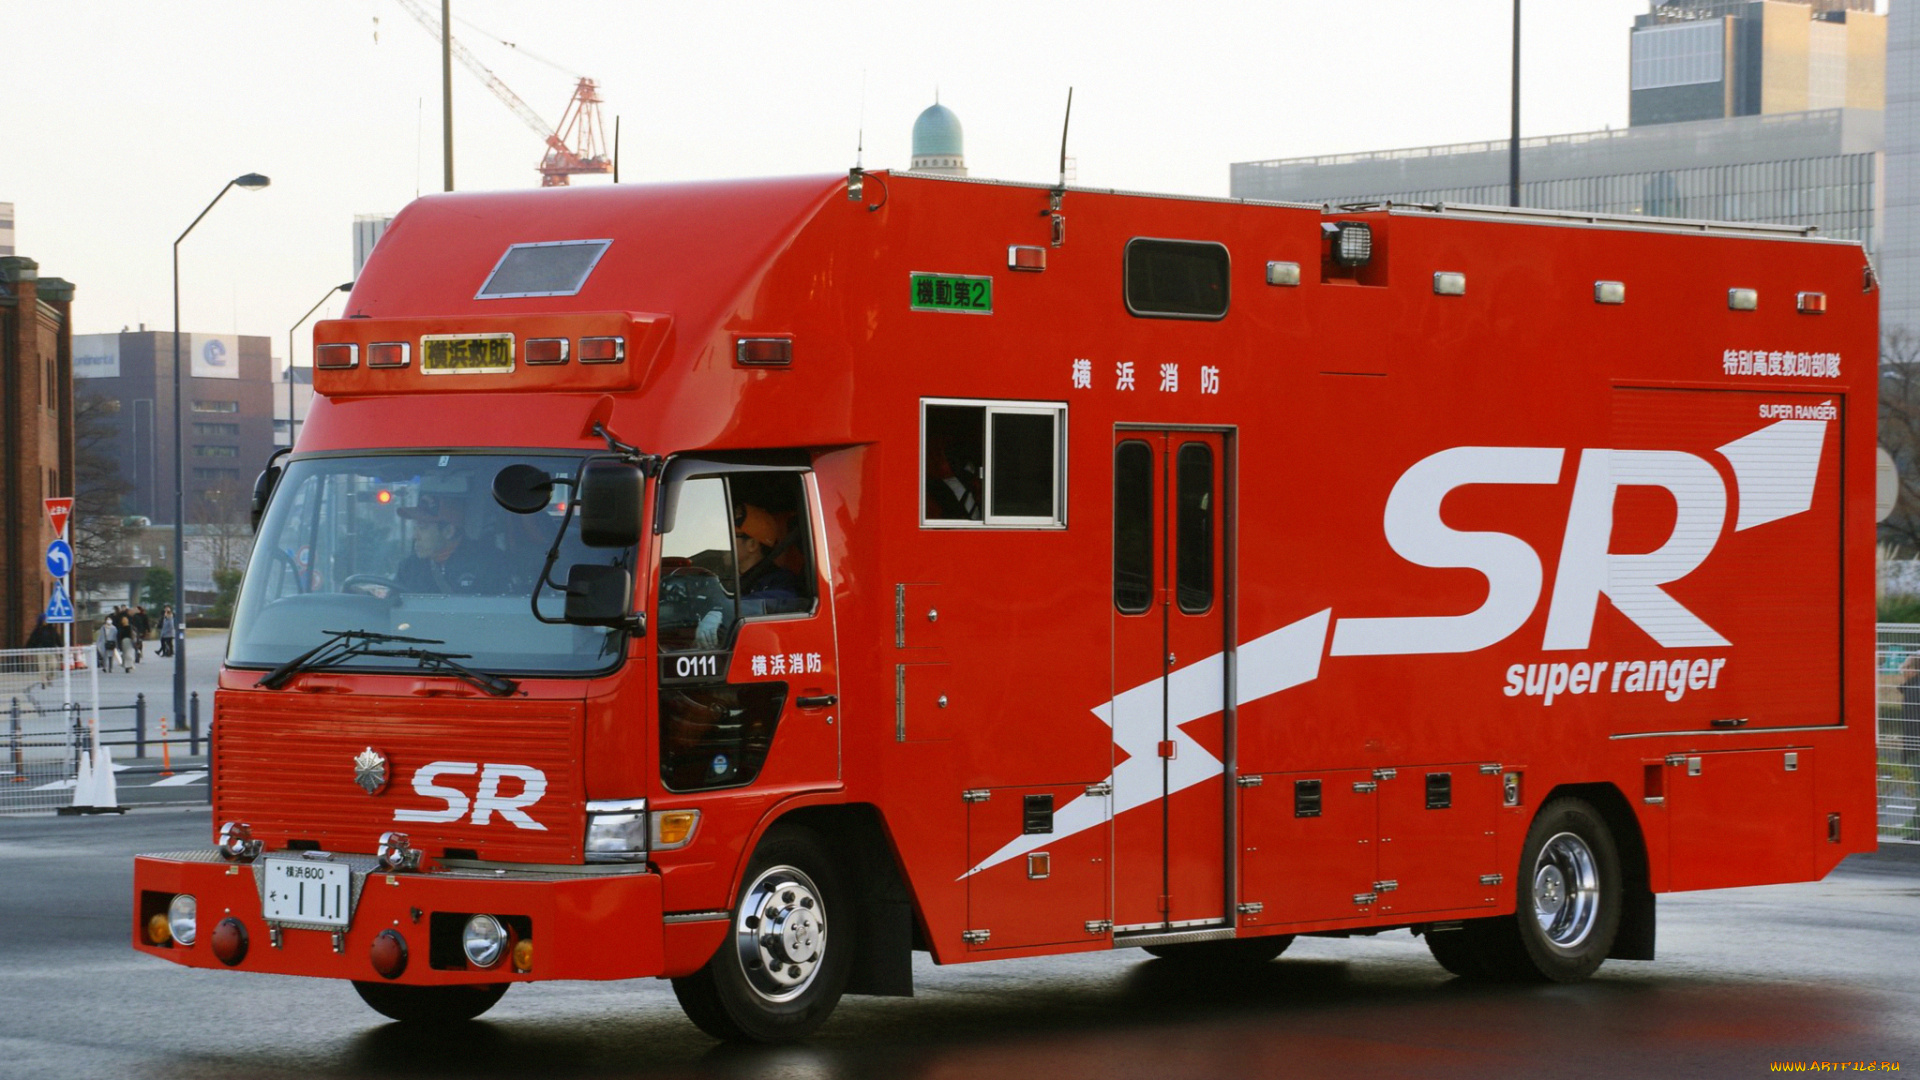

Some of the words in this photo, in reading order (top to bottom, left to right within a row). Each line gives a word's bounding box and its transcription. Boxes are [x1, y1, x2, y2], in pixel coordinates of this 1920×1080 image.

[916, 278, 986, 308] 機動第2
[428, 338, 509, 369] 横浜救助
[1722, 348, 1842, 379] 特別高度救助部隊
[1071, 357, 1221, 395] 横浜消防
[1758, 403, 1794, 419] SUPER
[1794, 404, 1838, 420] RANGER
[1329, 445, 1734, 657] SR
[676, 654, 717, 678] 0111
[751, 651, 823, 677] 横浜消防
[1502, 661, 1609, 707] super
[1610, 657, 1727, 703] ranger
[392, 760, 549, 832] SR
